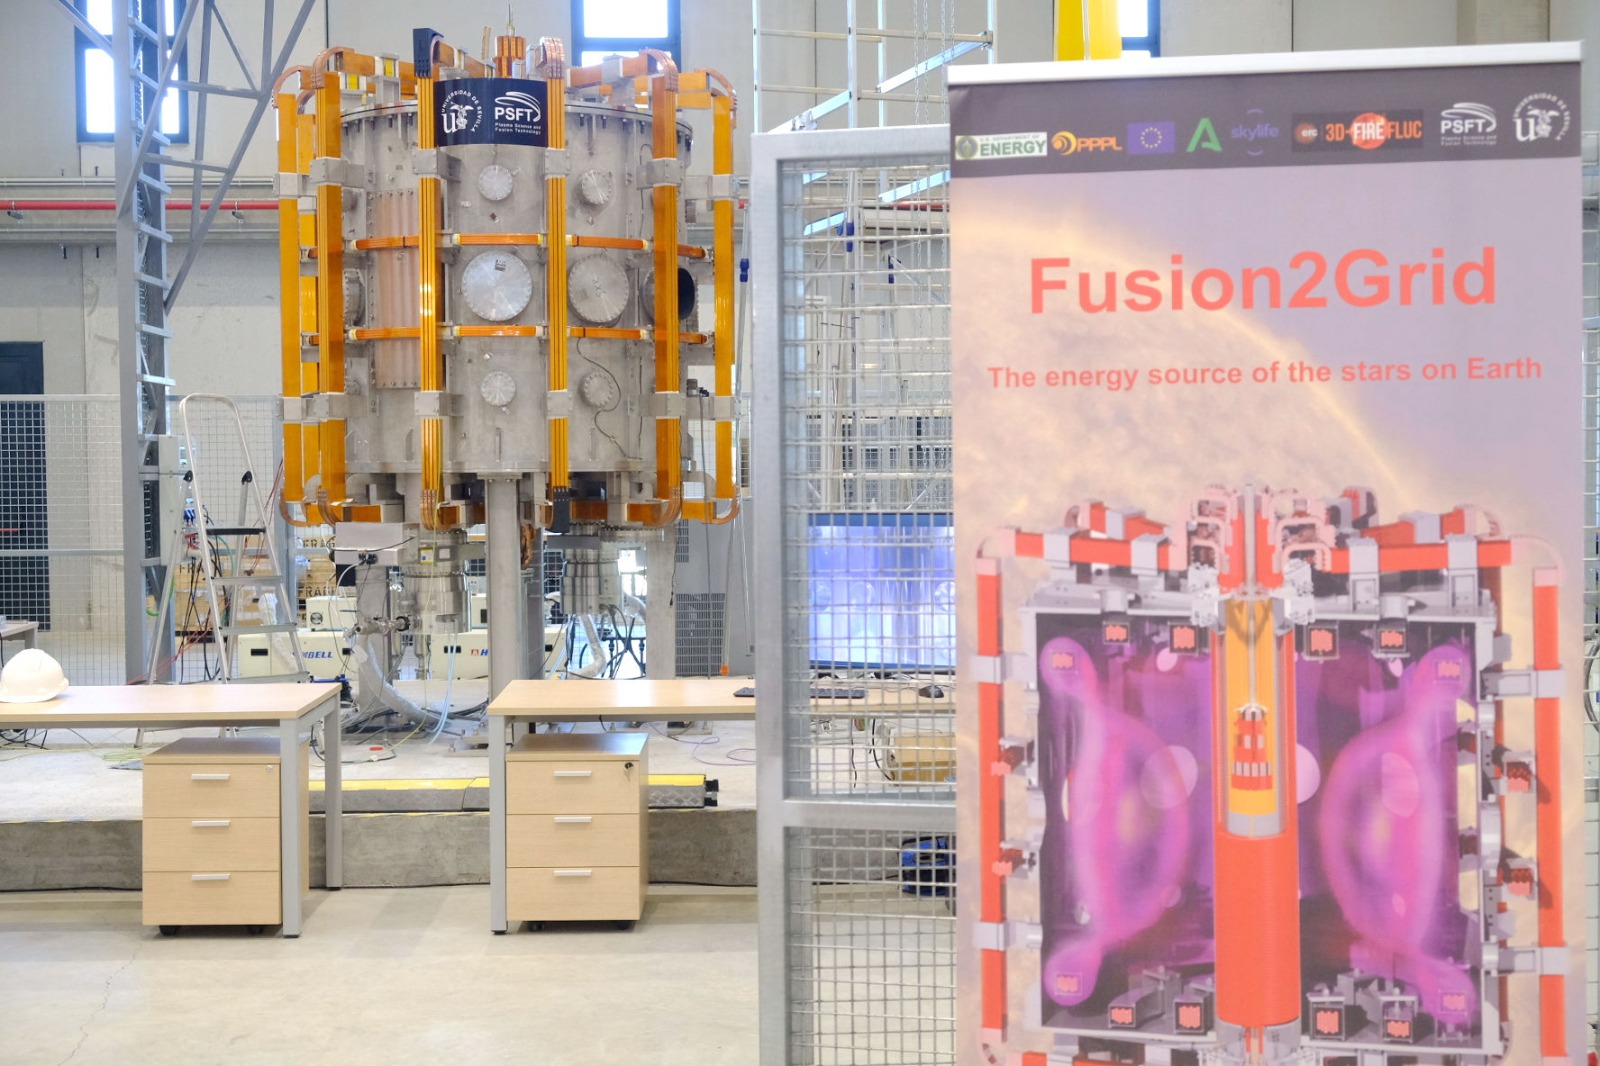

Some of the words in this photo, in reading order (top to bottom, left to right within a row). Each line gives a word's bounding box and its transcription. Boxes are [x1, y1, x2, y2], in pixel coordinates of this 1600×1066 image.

[441, 90, 471, 113] UNIVERSIDAD
[470, 105, 483, 132] SEVILLA
[494, 107, 533, 122] PSFT
[1301, 127, 1318, 138] erc
[1441, 119, 1487, 135] PSFT
[979, 139, 1047, 156] ENERGY
[1077, 137, 1122, 151] PPPL
[1030, 246, 1496, 315] Fusion2Grid
[987, 365, 1037, 389] The
[1045, 368, 1139, 392] energy
[1148, 364, 1242, 386] source
[1252, 361, 1280, 384] of
[1288, 361, 1332, 383] the
[1341, 360, 1411, 382] stars
[1421, 361, 1457, 381] on
[1467, 356, 1542, 380] Earth
